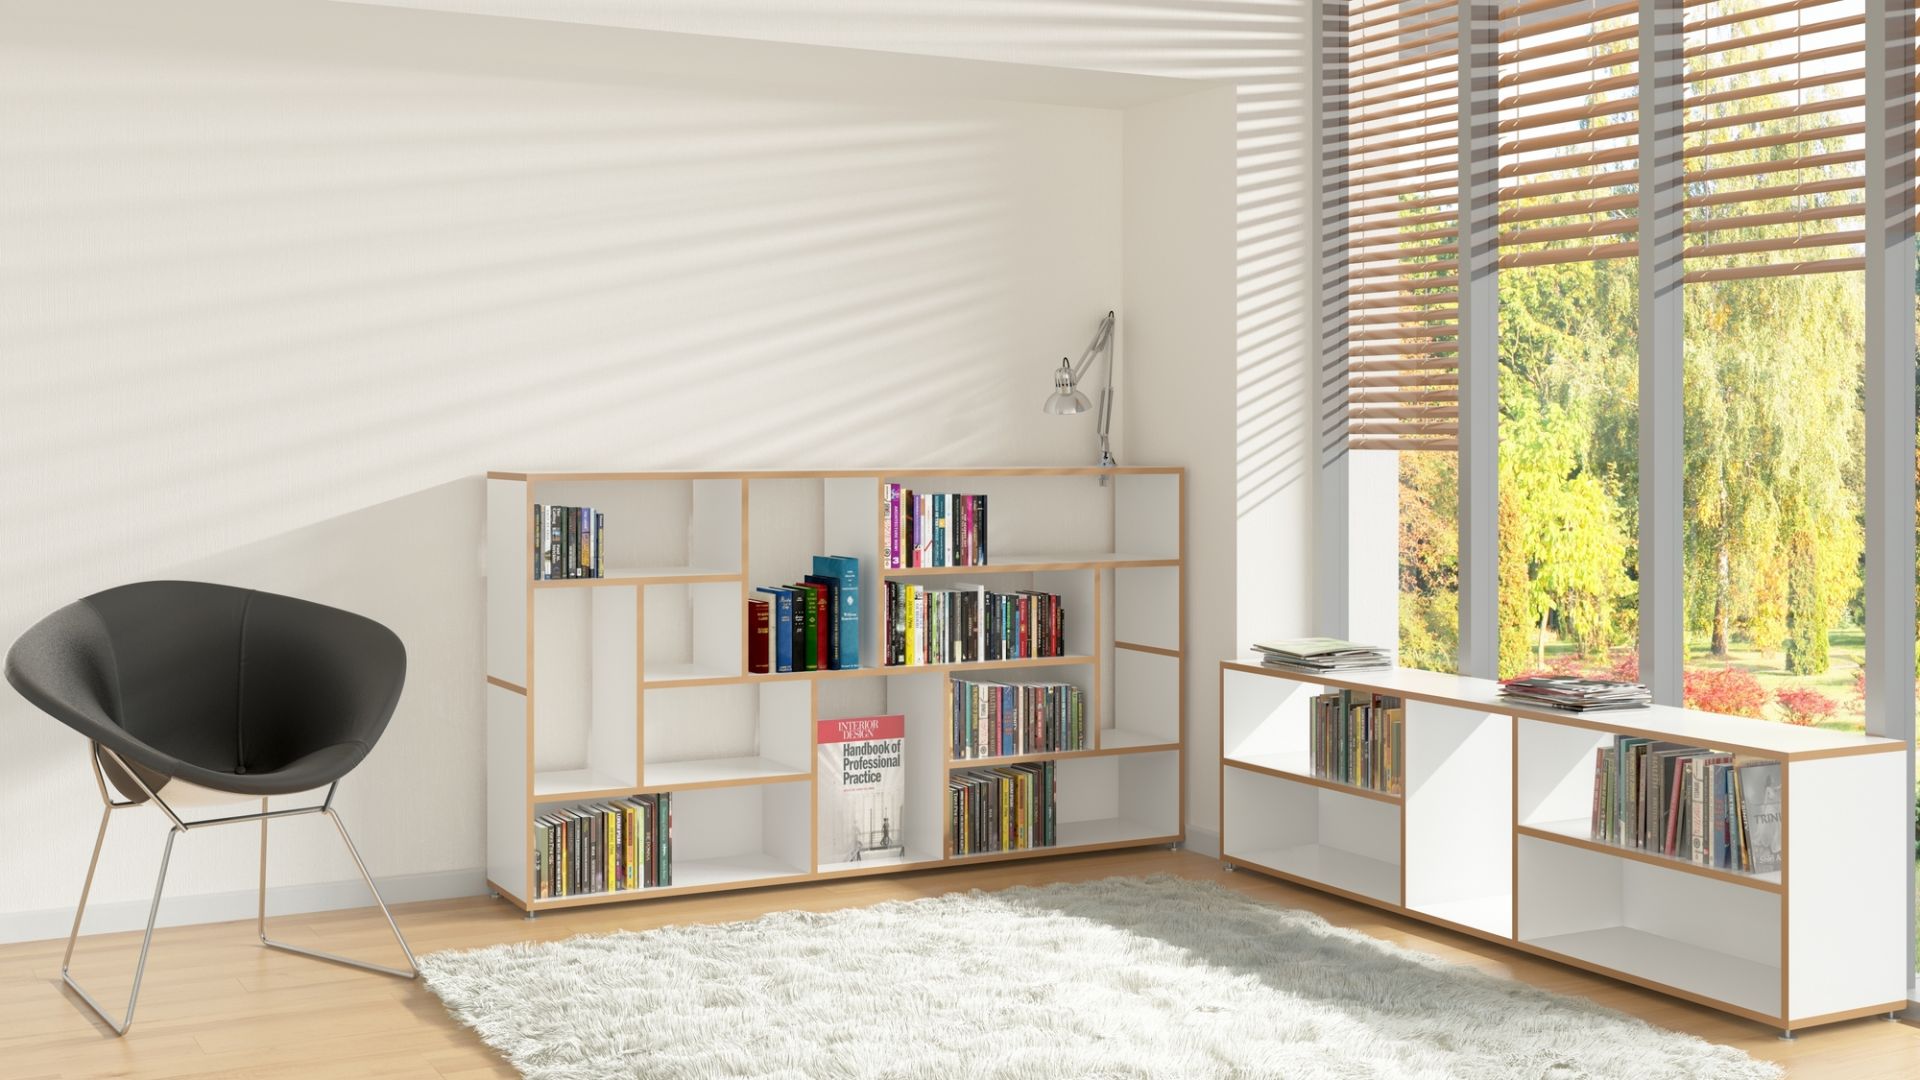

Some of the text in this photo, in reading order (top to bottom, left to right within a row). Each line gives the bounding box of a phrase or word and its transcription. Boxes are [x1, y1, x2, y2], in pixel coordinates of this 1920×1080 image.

[892, 556, 899, 565] 3
[838, 719, 879, 732] INTERIOR
[843, 728, 874, 740] DESIGN
[843, 739, 902, 757] Handbook of
[843, 754, 901, 771] Professional
[843, 770, 882, 785] Practice
